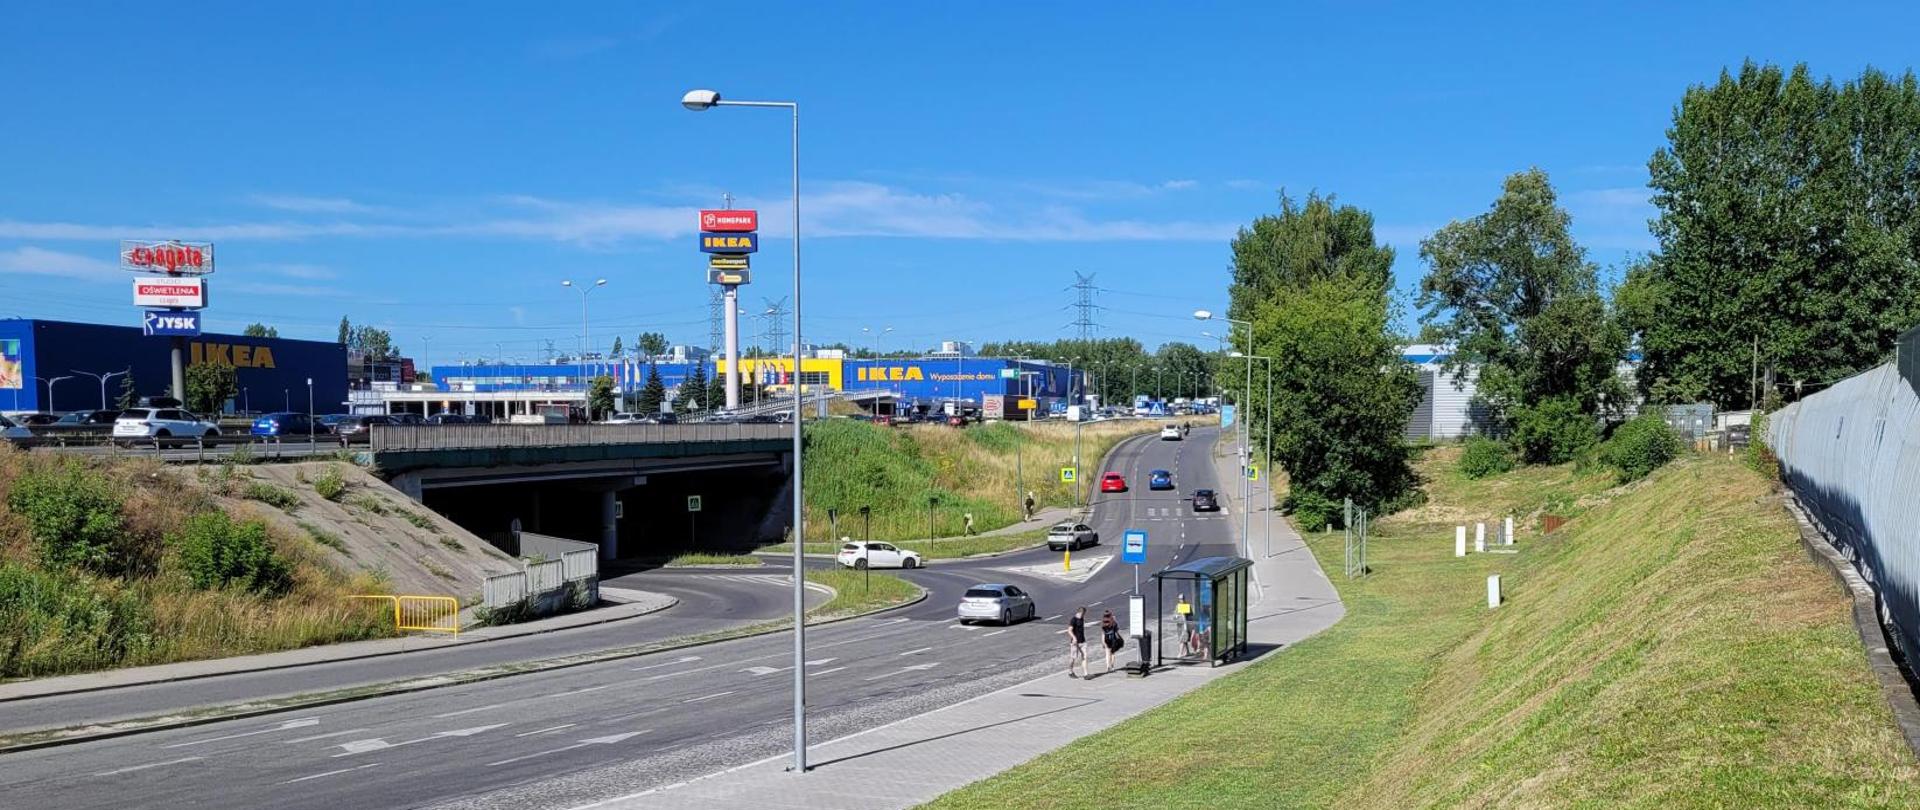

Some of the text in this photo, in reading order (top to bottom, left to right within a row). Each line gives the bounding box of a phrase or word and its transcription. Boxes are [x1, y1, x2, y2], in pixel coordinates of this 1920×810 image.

[704, 237, 751, 247] IKEA
[156, 316, 196, 330] JYSK
[190, 343, 275, 368] IKEA
[857, 367, 924, 381] IKEA
